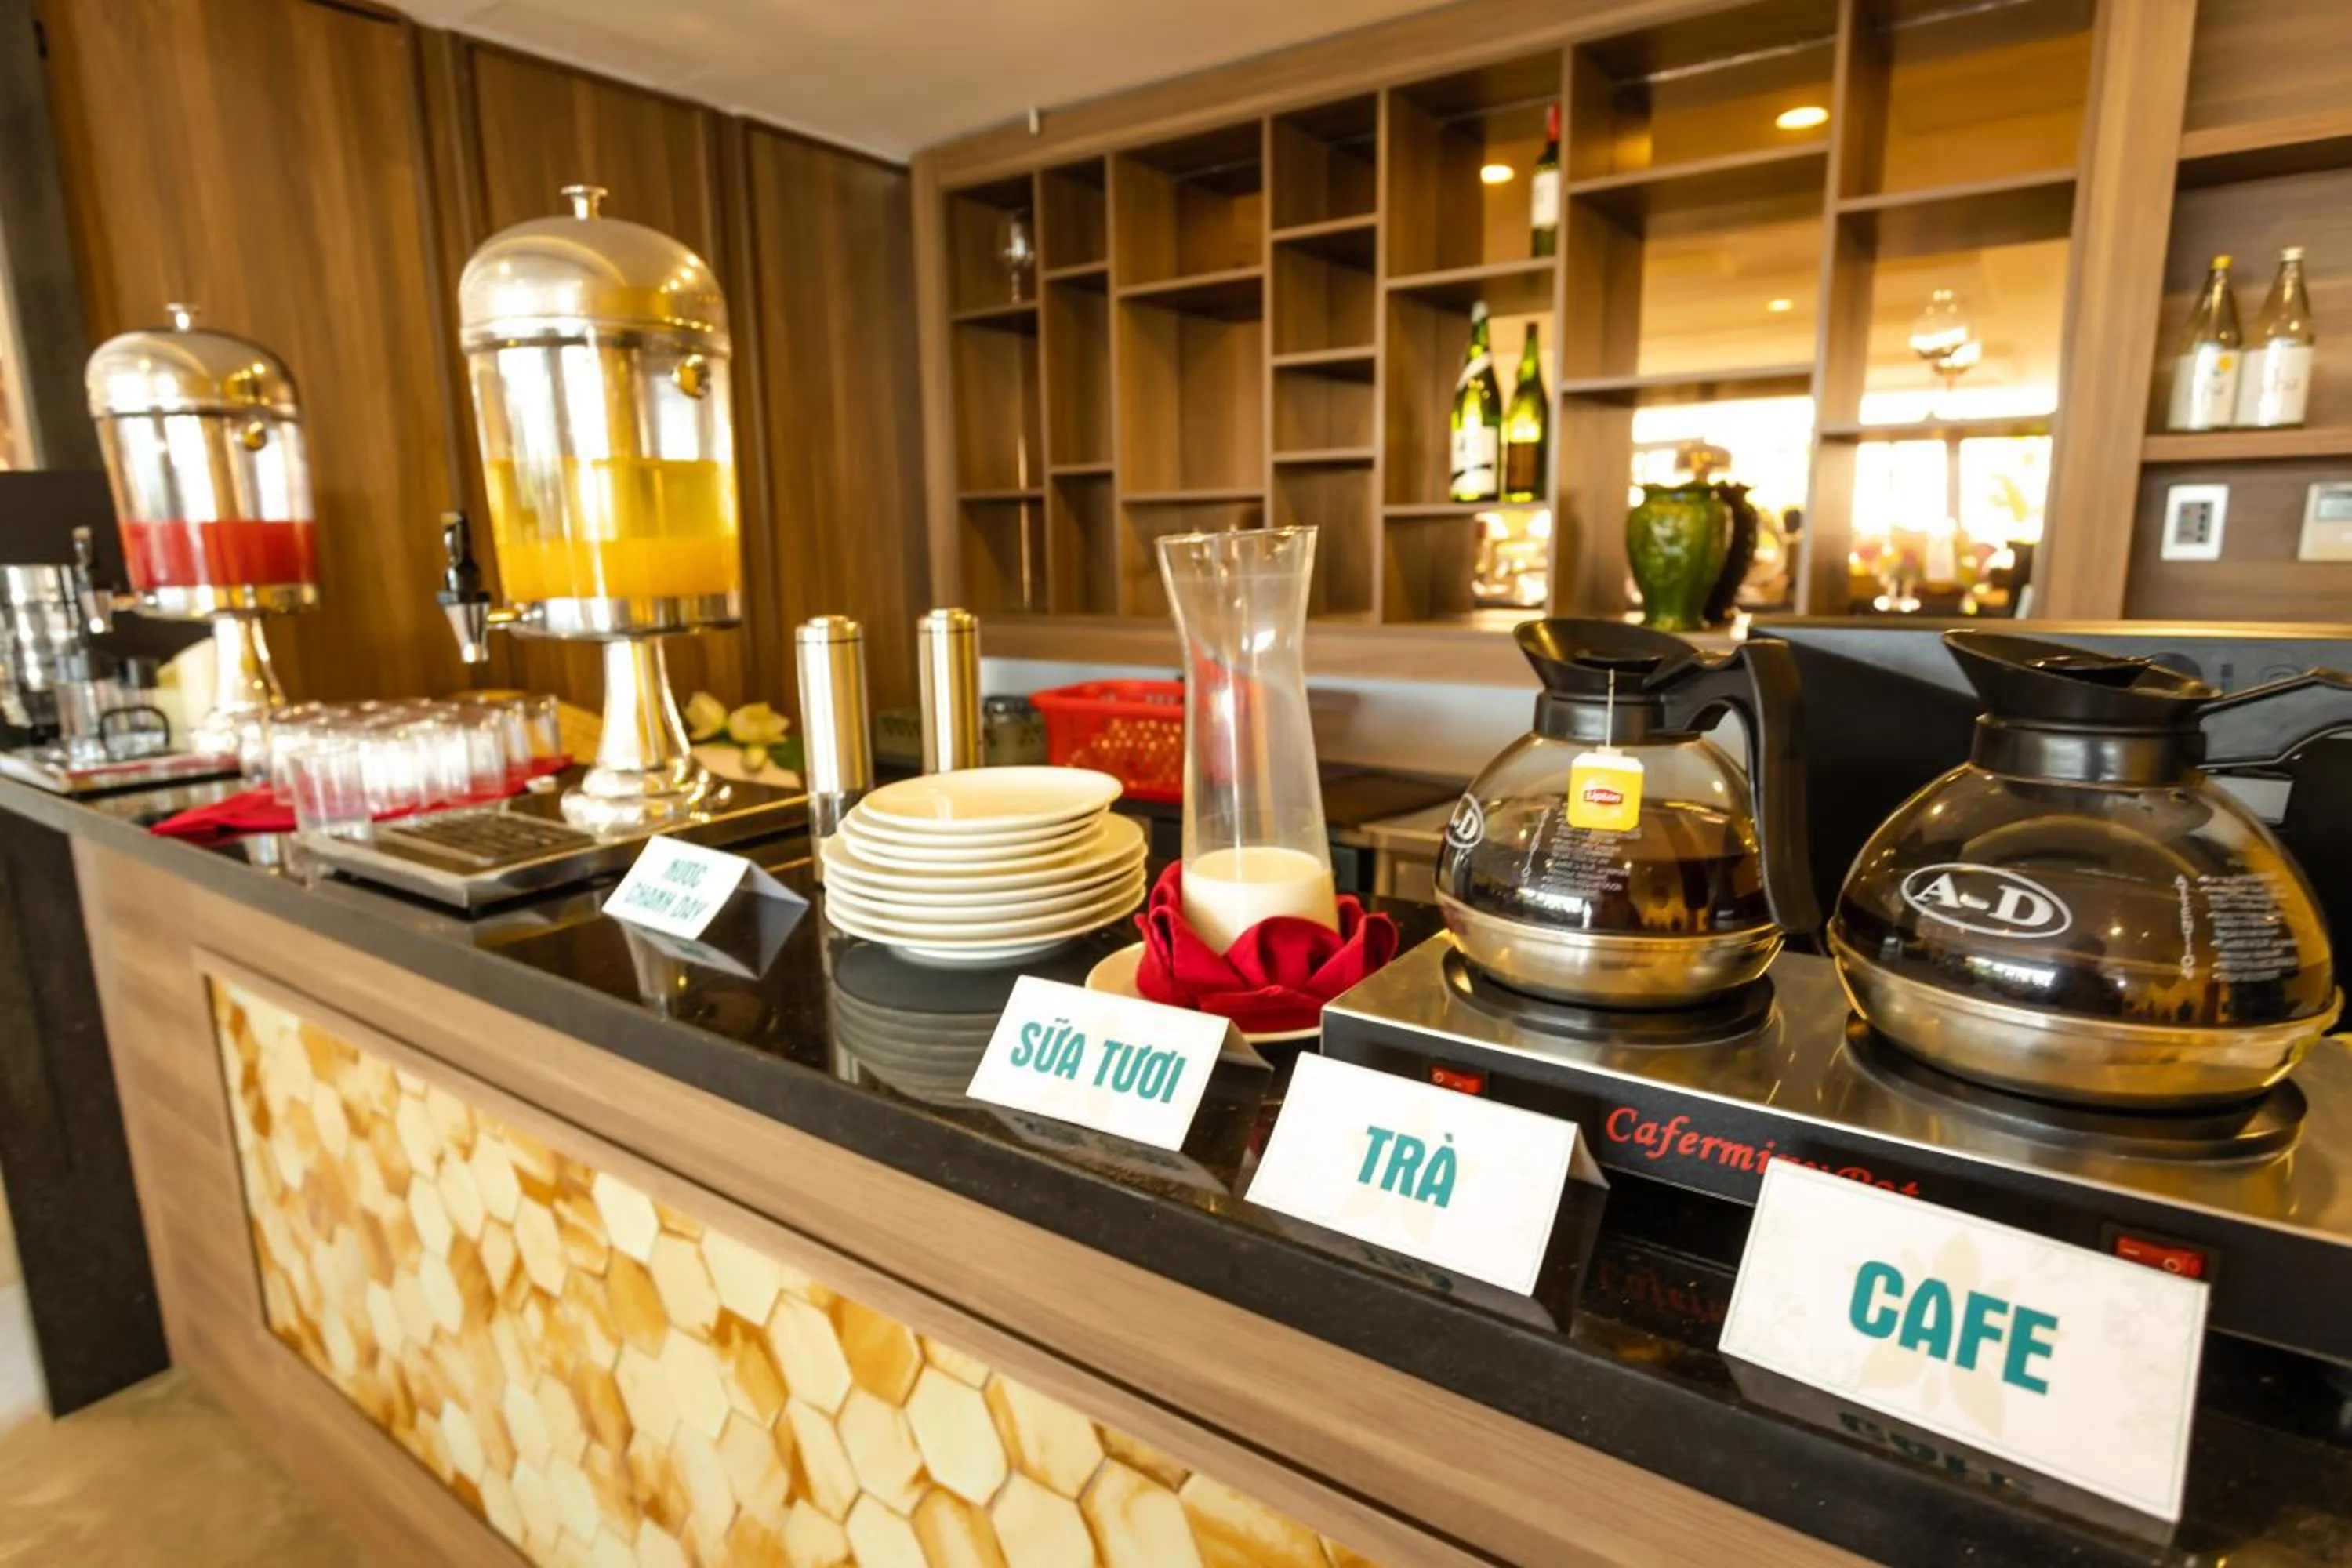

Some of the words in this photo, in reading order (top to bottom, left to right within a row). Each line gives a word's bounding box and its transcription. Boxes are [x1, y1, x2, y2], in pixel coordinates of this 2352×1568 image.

[1913, 873, 2054, 927] A-D
[1011, 1018, 1087, 1080] SỮA
[1093, 1039, 1187, 1104] TƯƠI
[1357, 1124, 1457, 1209] TRÀ
[1849, 1260, 2059, 1396] CAFE
